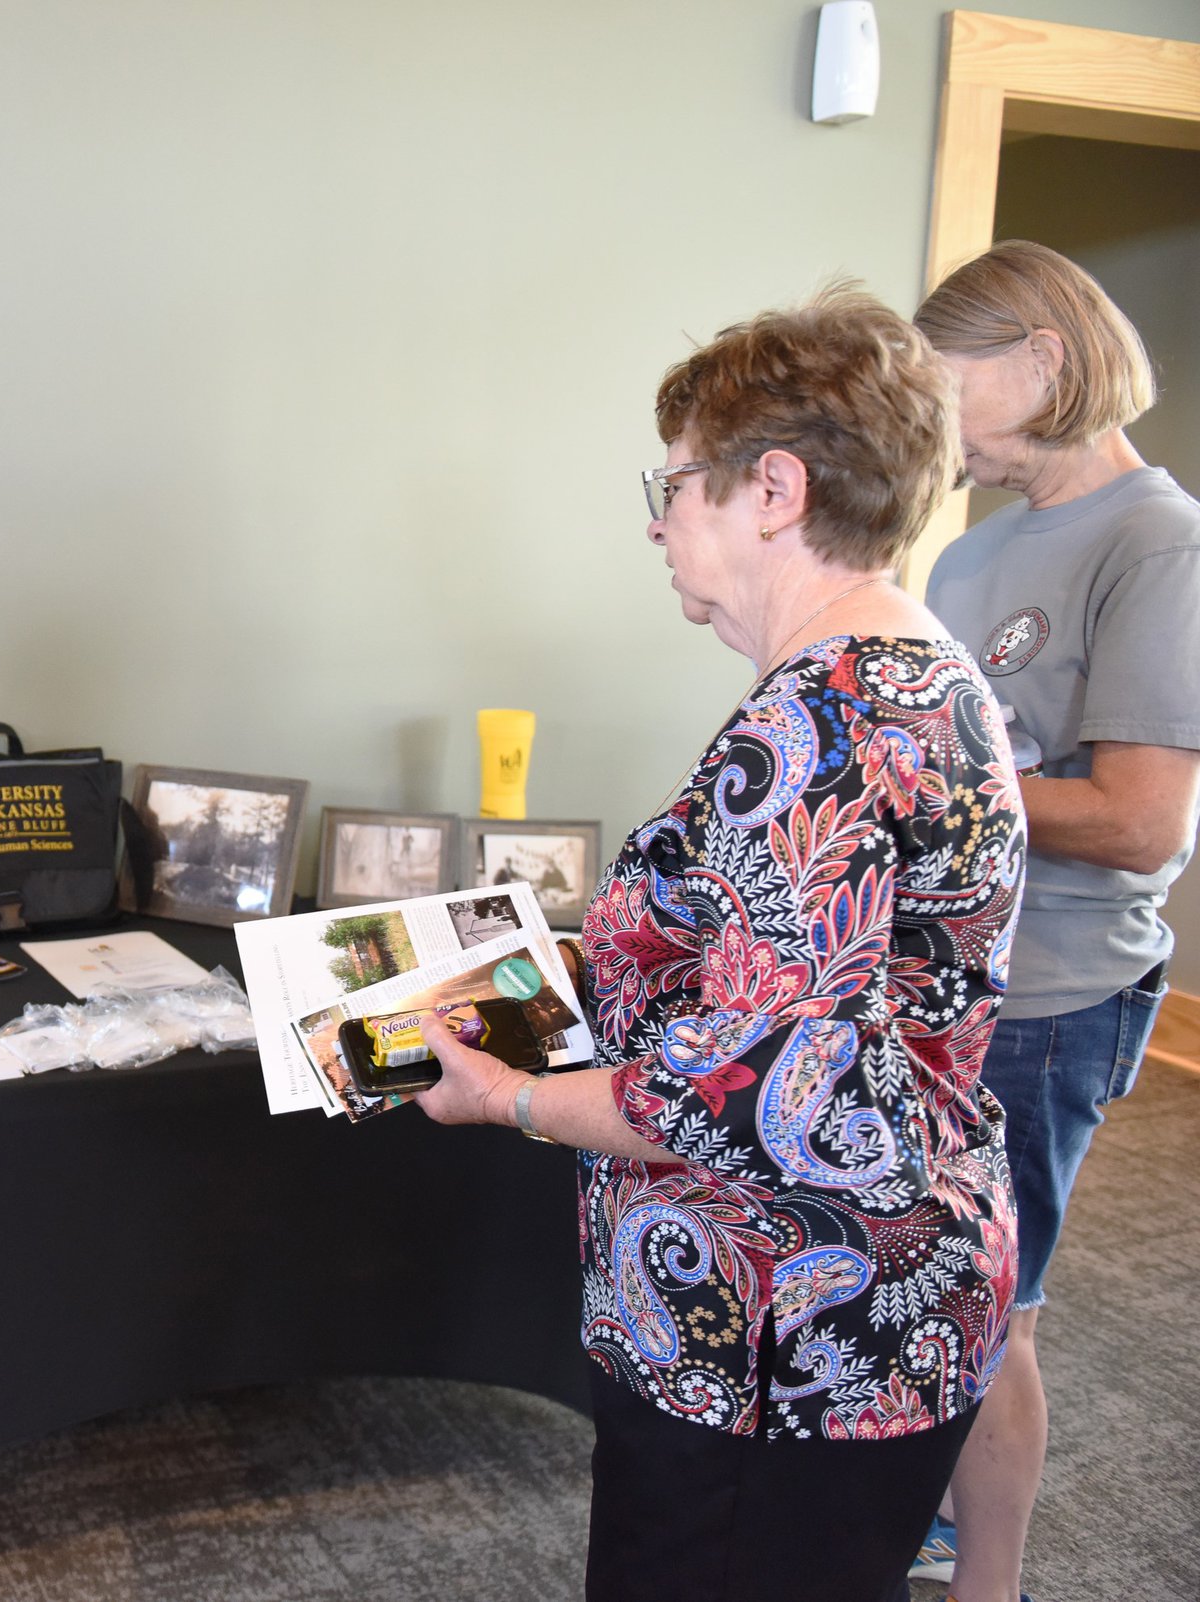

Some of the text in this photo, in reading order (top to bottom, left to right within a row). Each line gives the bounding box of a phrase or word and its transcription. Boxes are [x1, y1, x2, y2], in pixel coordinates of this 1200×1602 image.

[23, 820, 66, 831] BLUFF
[30, 838, 74, 851] Sciences
[381, 1016, 421, 1037] Newto
